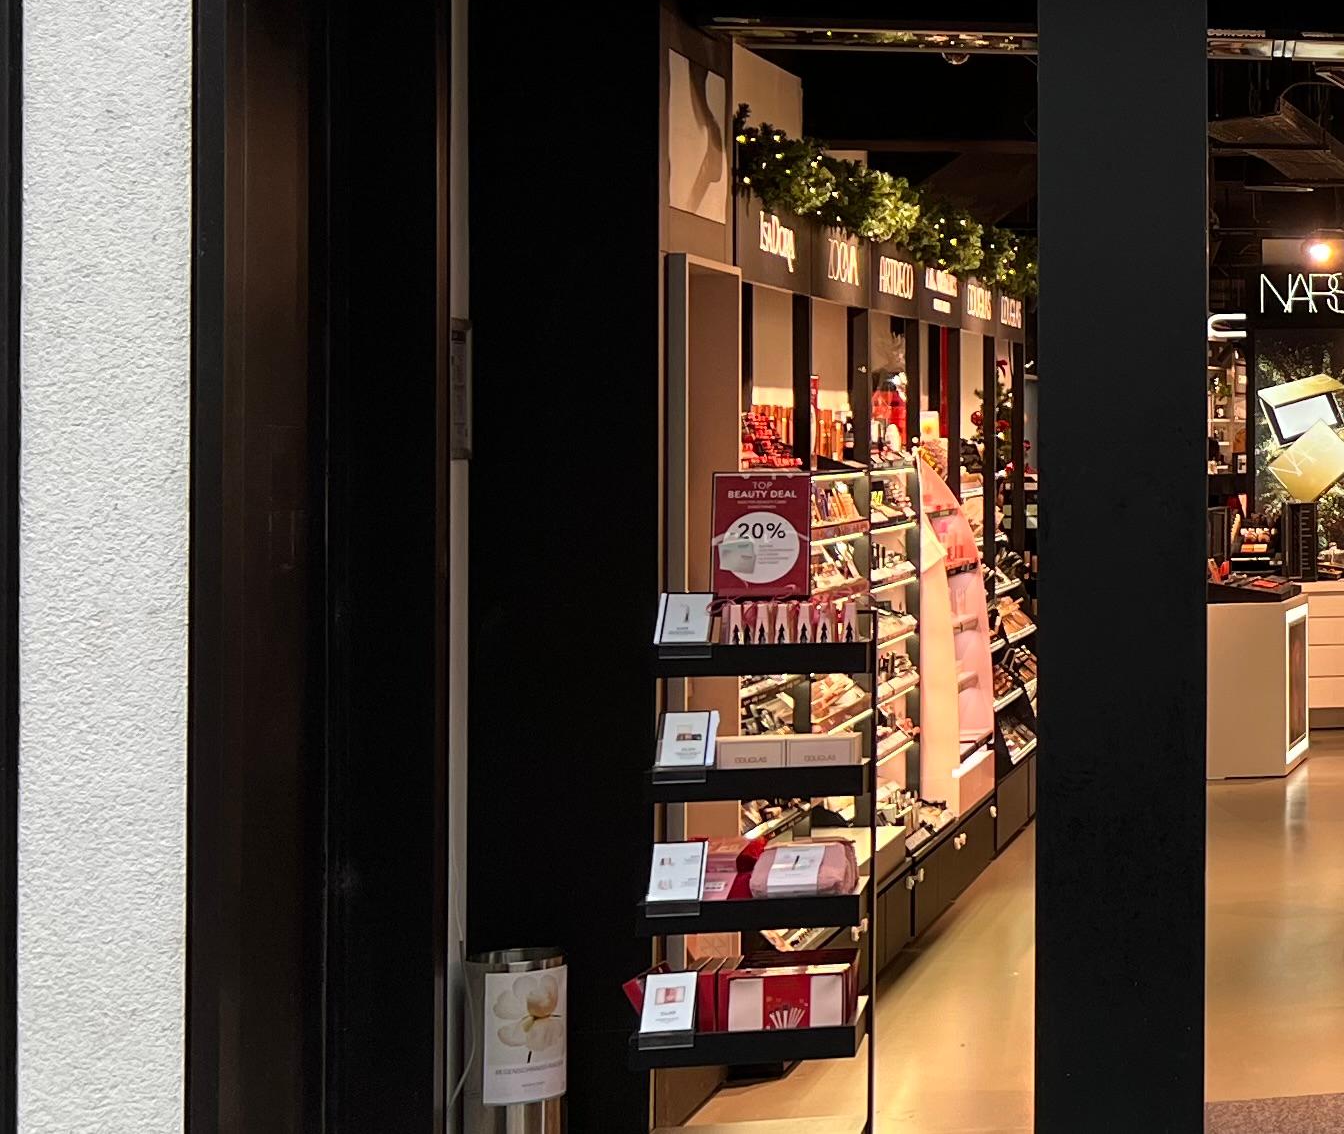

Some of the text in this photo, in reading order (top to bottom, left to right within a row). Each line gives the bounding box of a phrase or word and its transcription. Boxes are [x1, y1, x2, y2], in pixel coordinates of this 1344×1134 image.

[879, 255, 914, 301] ARTDECO
[751, 481, 773, 490] TOP
[727, 489, 798, 499] BEAUTY DEAL
